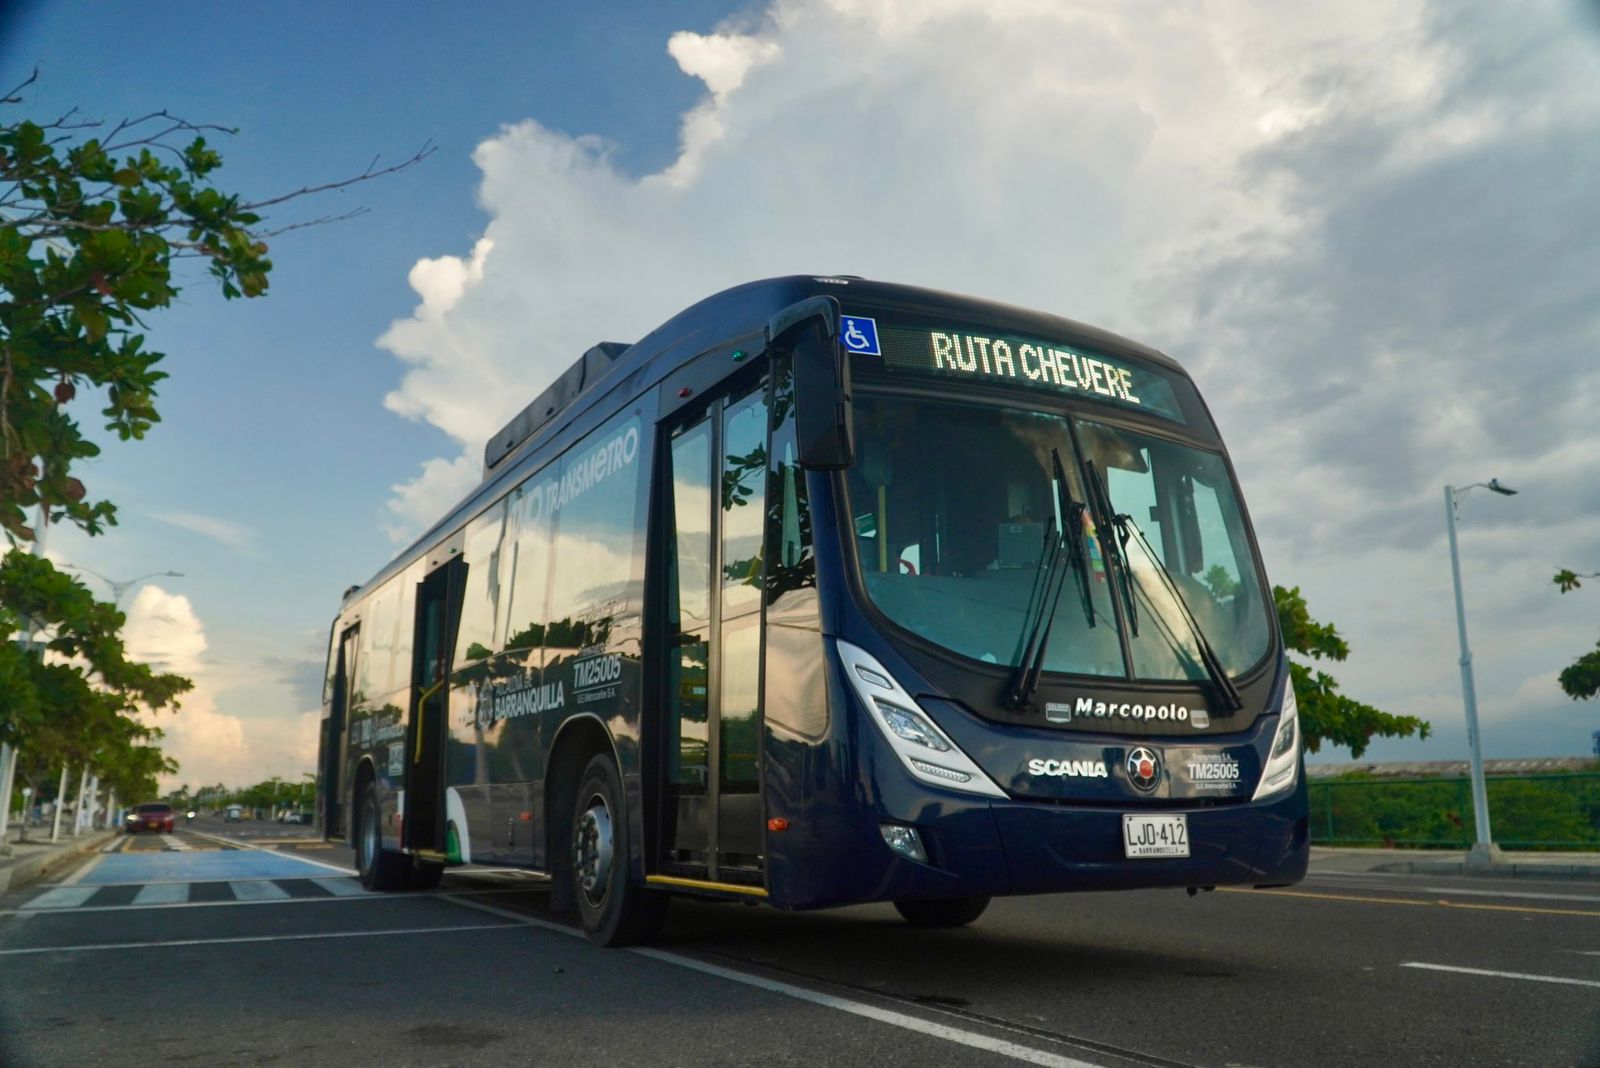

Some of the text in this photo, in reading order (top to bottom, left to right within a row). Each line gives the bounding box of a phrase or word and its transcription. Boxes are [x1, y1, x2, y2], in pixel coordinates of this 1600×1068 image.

[931, 332, 1141, 404] RUTA CHEVERE
[573, 654, 621, 689] TM25005
[494, 680, 565, 721] BARRANQUILLA
[1074, 698, 1188, 721] Marcopolo
[1028, 758, 1108, 778] SCANIA
[1187, 763, 1240, 779] TM25005
